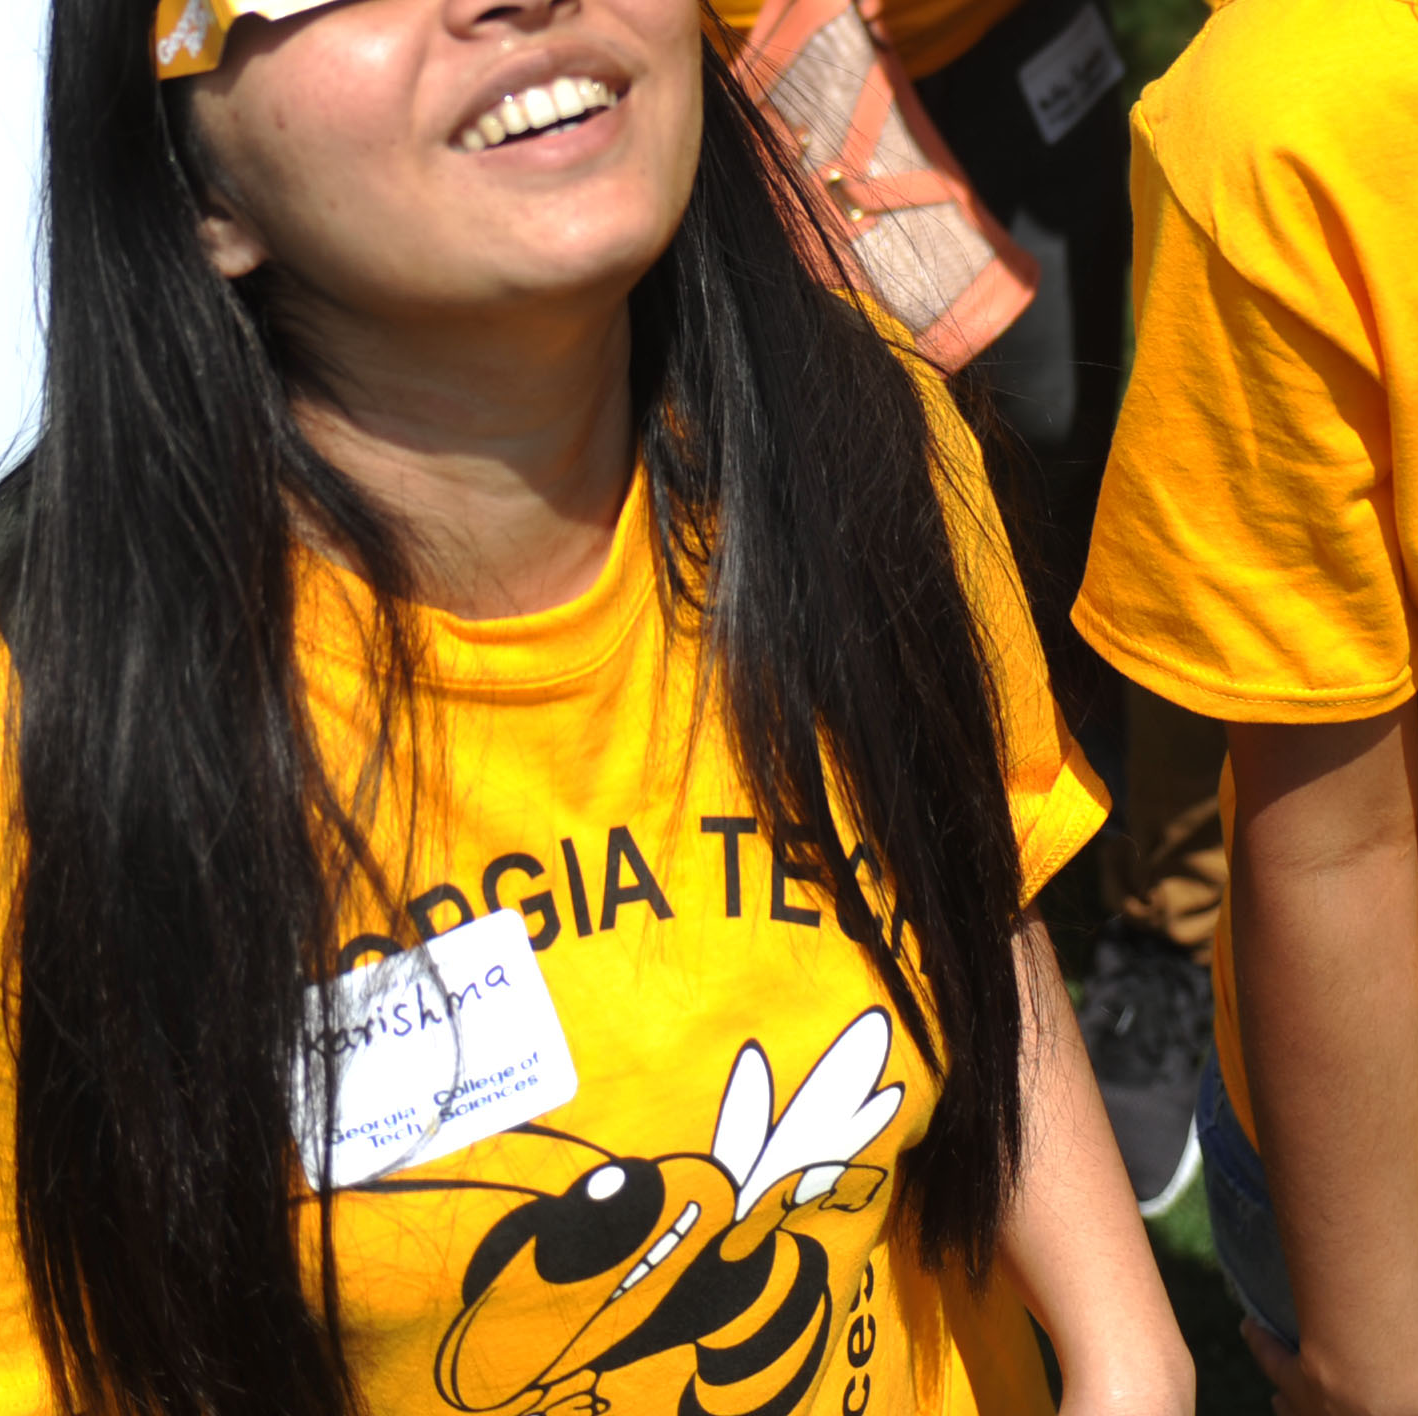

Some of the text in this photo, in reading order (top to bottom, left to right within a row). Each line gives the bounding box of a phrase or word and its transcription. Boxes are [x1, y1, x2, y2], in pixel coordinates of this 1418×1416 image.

[330, 1051, 540, 1146] Georgia College of
[367, 1074, 539, 1149] Tech Sciences
